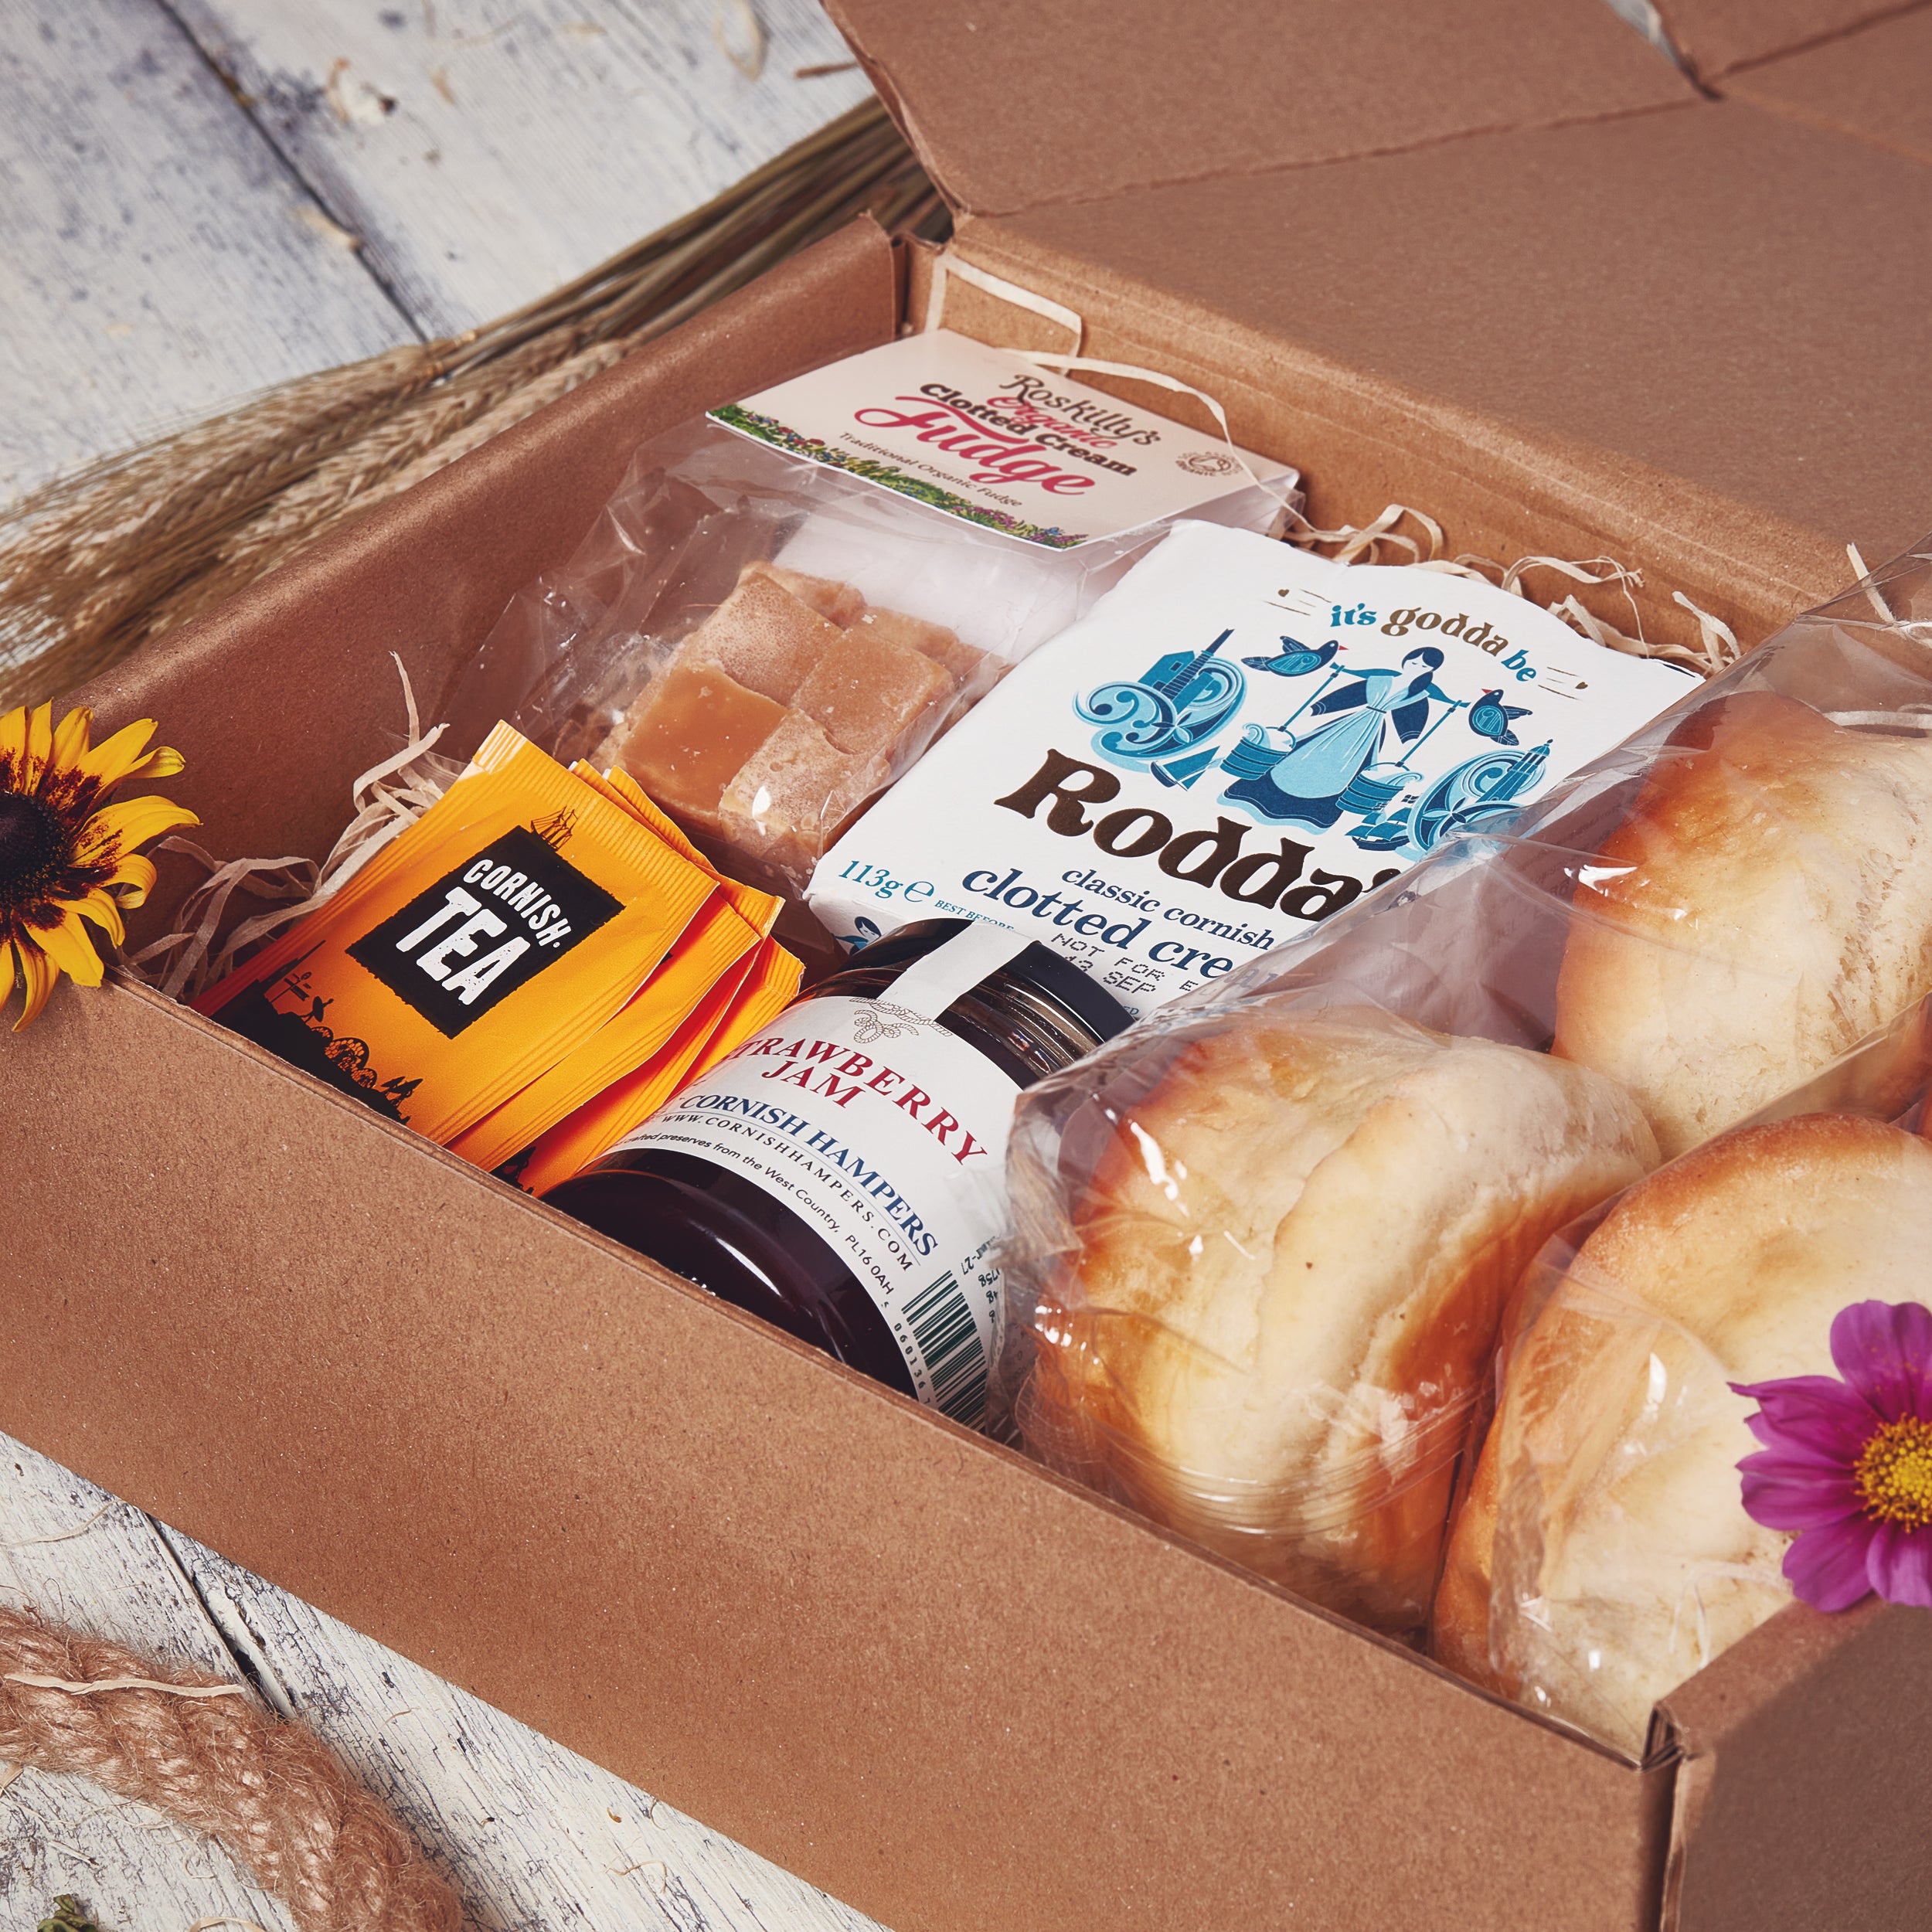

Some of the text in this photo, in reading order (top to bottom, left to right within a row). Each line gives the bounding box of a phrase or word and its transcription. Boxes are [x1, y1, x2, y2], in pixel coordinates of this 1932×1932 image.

[854, 396, 1096, 495] Fudge
[920, 383, 1039, 436] Clotted
[1035, 433, 1138, 477] Cream
[987, 396, 1118, 450] Organic
[998, 374, 1162, 447] Roskilly's
[839, 432, 1023, 508] Traditional Organic Fudge
[1330, 603, 1537, 682] it's godda be
[994, 749, 1400, 923] Rodda'
[395, 886, 532, 1005] TEA
[462, 859, 572, 947] CORNISH
[934, 899, 1015, 931] BEST BEF
[961, 868, 1261, 988] clotted cre
[1061, 869, 1276, 951] classic cornish
[1050, 932, 1106, 957] NOT
[1114, 956, 1166, 981] FOR
[1102, 971, 1157, 994] SEP
[725, 1036, 988, 1166] TRAWBERRY
[760, 1060, 866, 1109] JAM
[658, 1133, 712, 1148] preserves
[713, 1143, 741, 1159] from
[742, 1155, 764, 1171] the
[764, 1165, 796, 1192] West
[795, 1188, 841, 1233] Country,
[845, 1234, 872, 1266] PL16
[662, 1114, 914, 1273] WWW.CORNISHHAMPERS.COM
[679, 1094, 939, 1257] CORNISH HAMPERS
